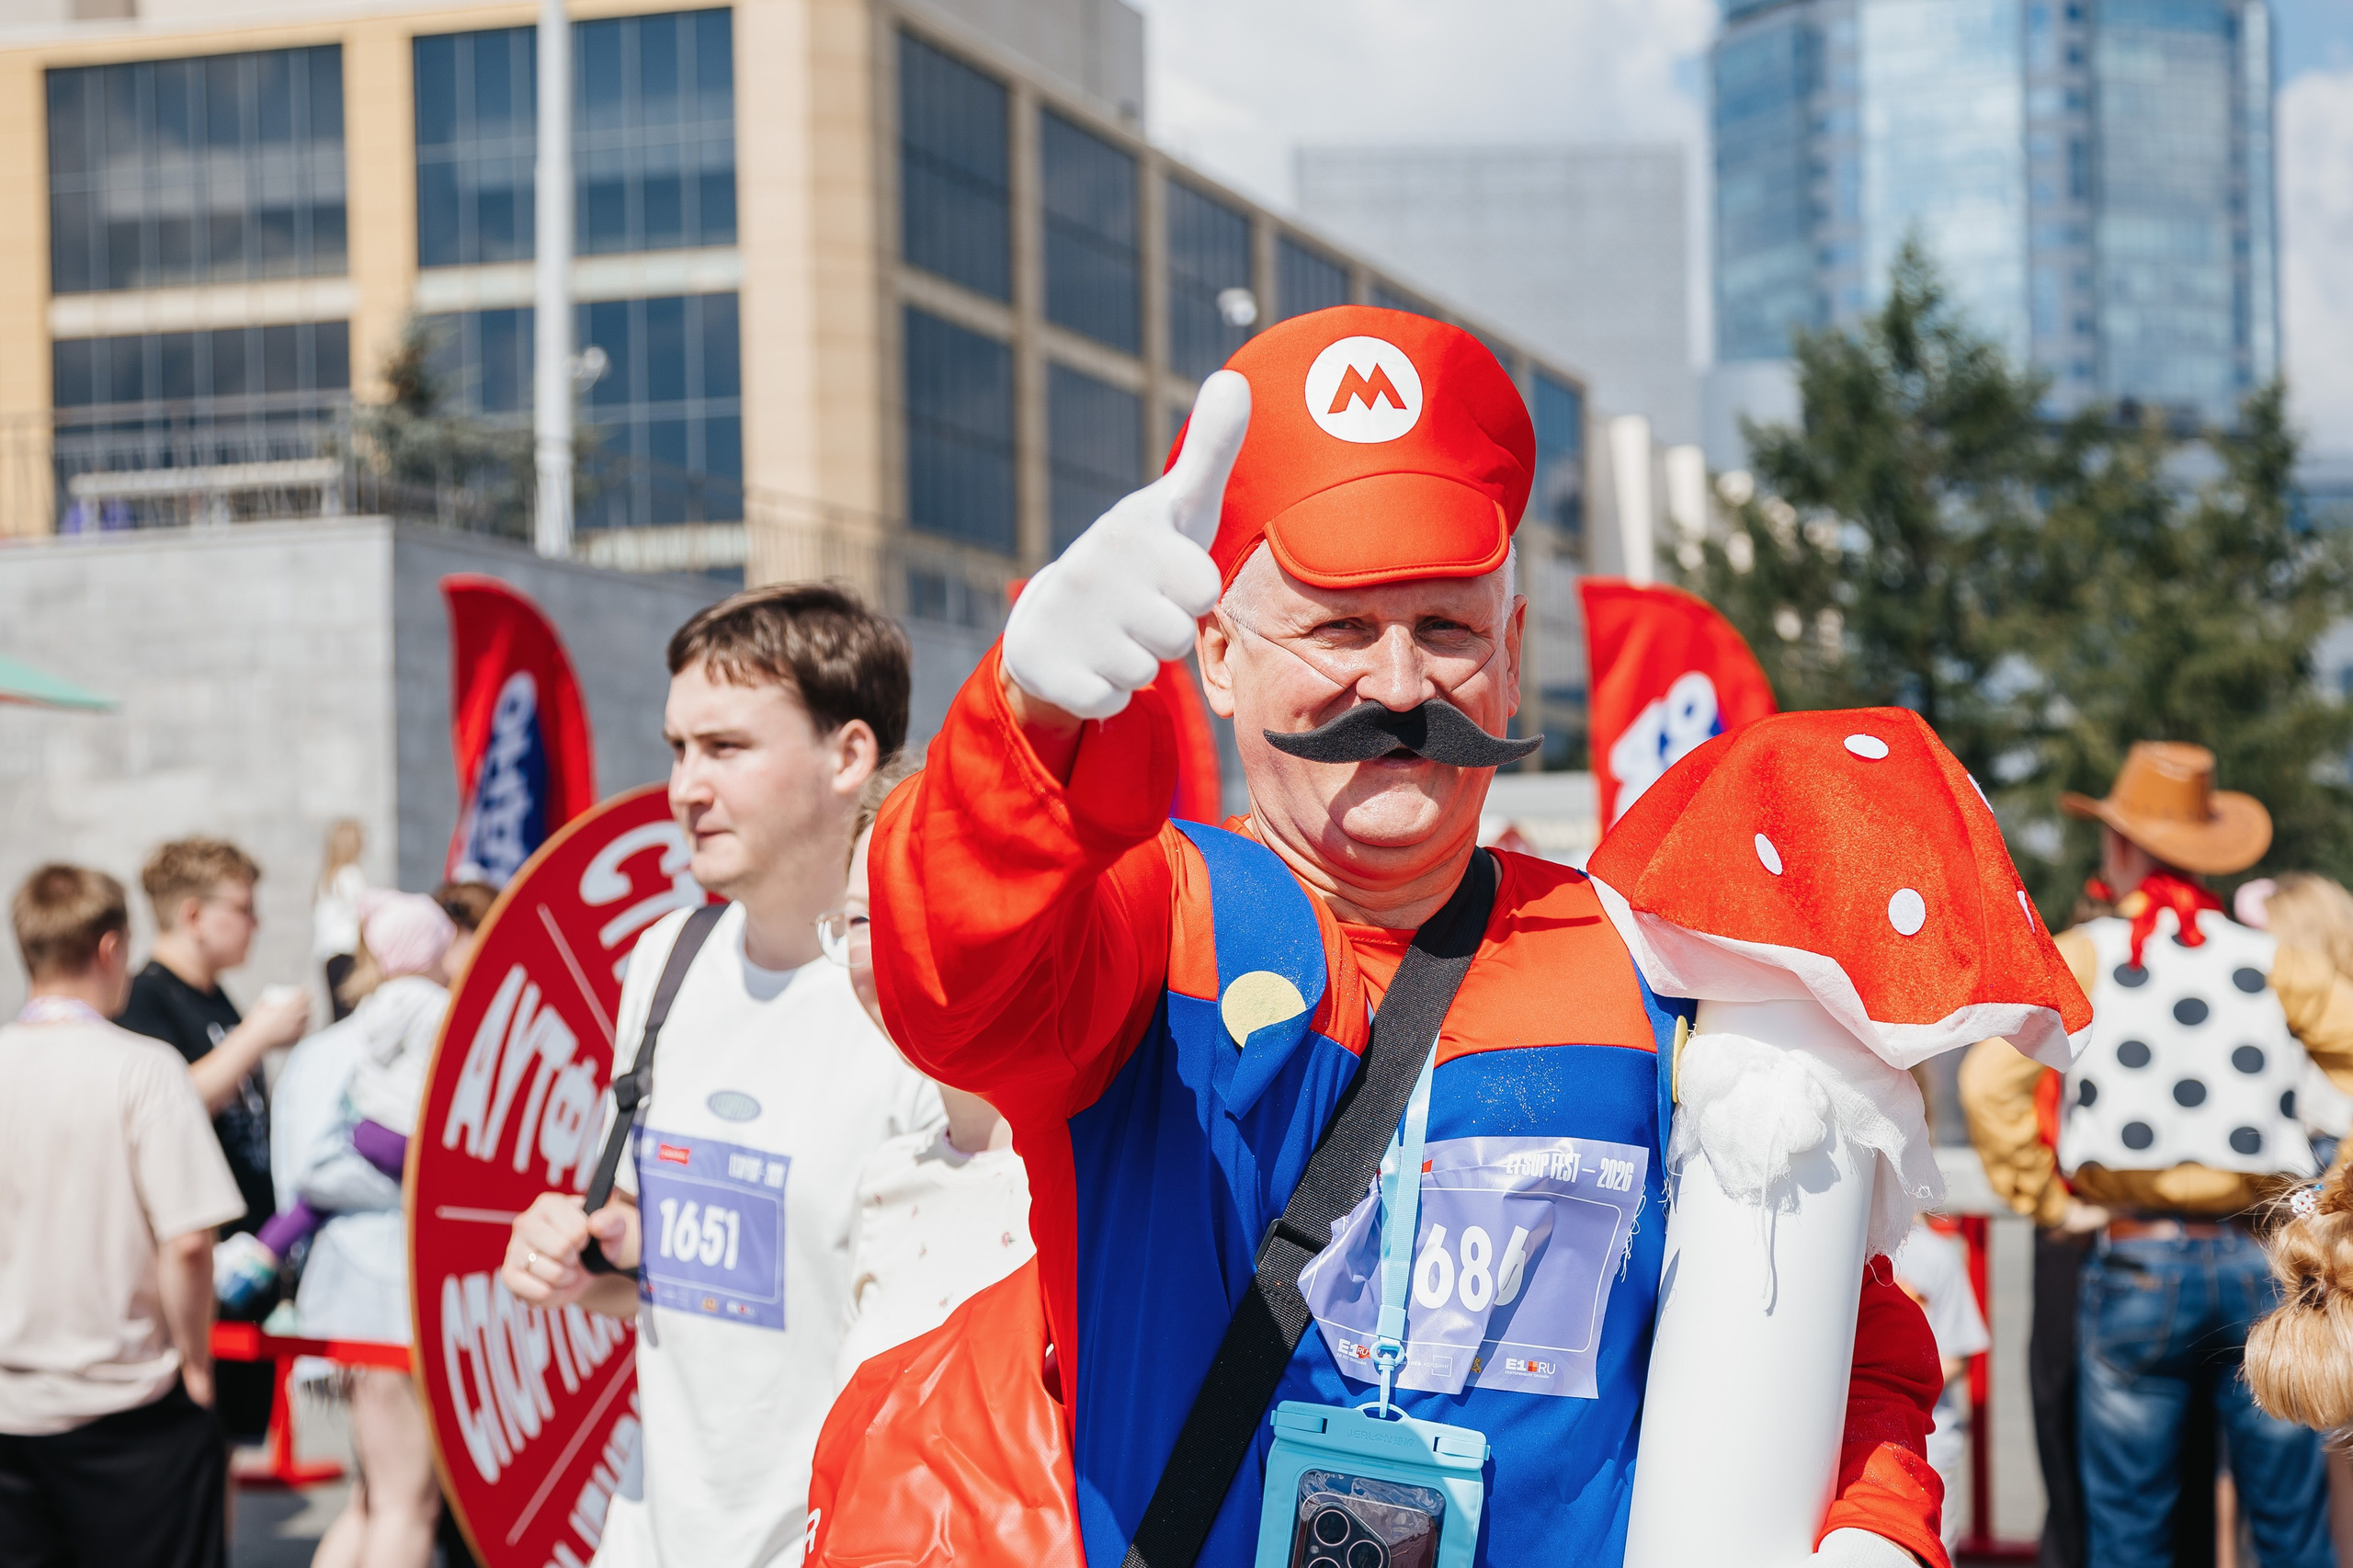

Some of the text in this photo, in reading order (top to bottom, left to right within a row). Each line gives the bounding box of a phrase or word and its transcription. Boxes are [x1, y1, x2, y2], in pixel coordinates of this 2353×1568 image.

[1327, 362, 1407, 414] M
[1550, 1152, 1582, 1183] FEST
[1597, 1157, 1634, 1192] 2026
[659, 1197, 741, 1270] 1651
